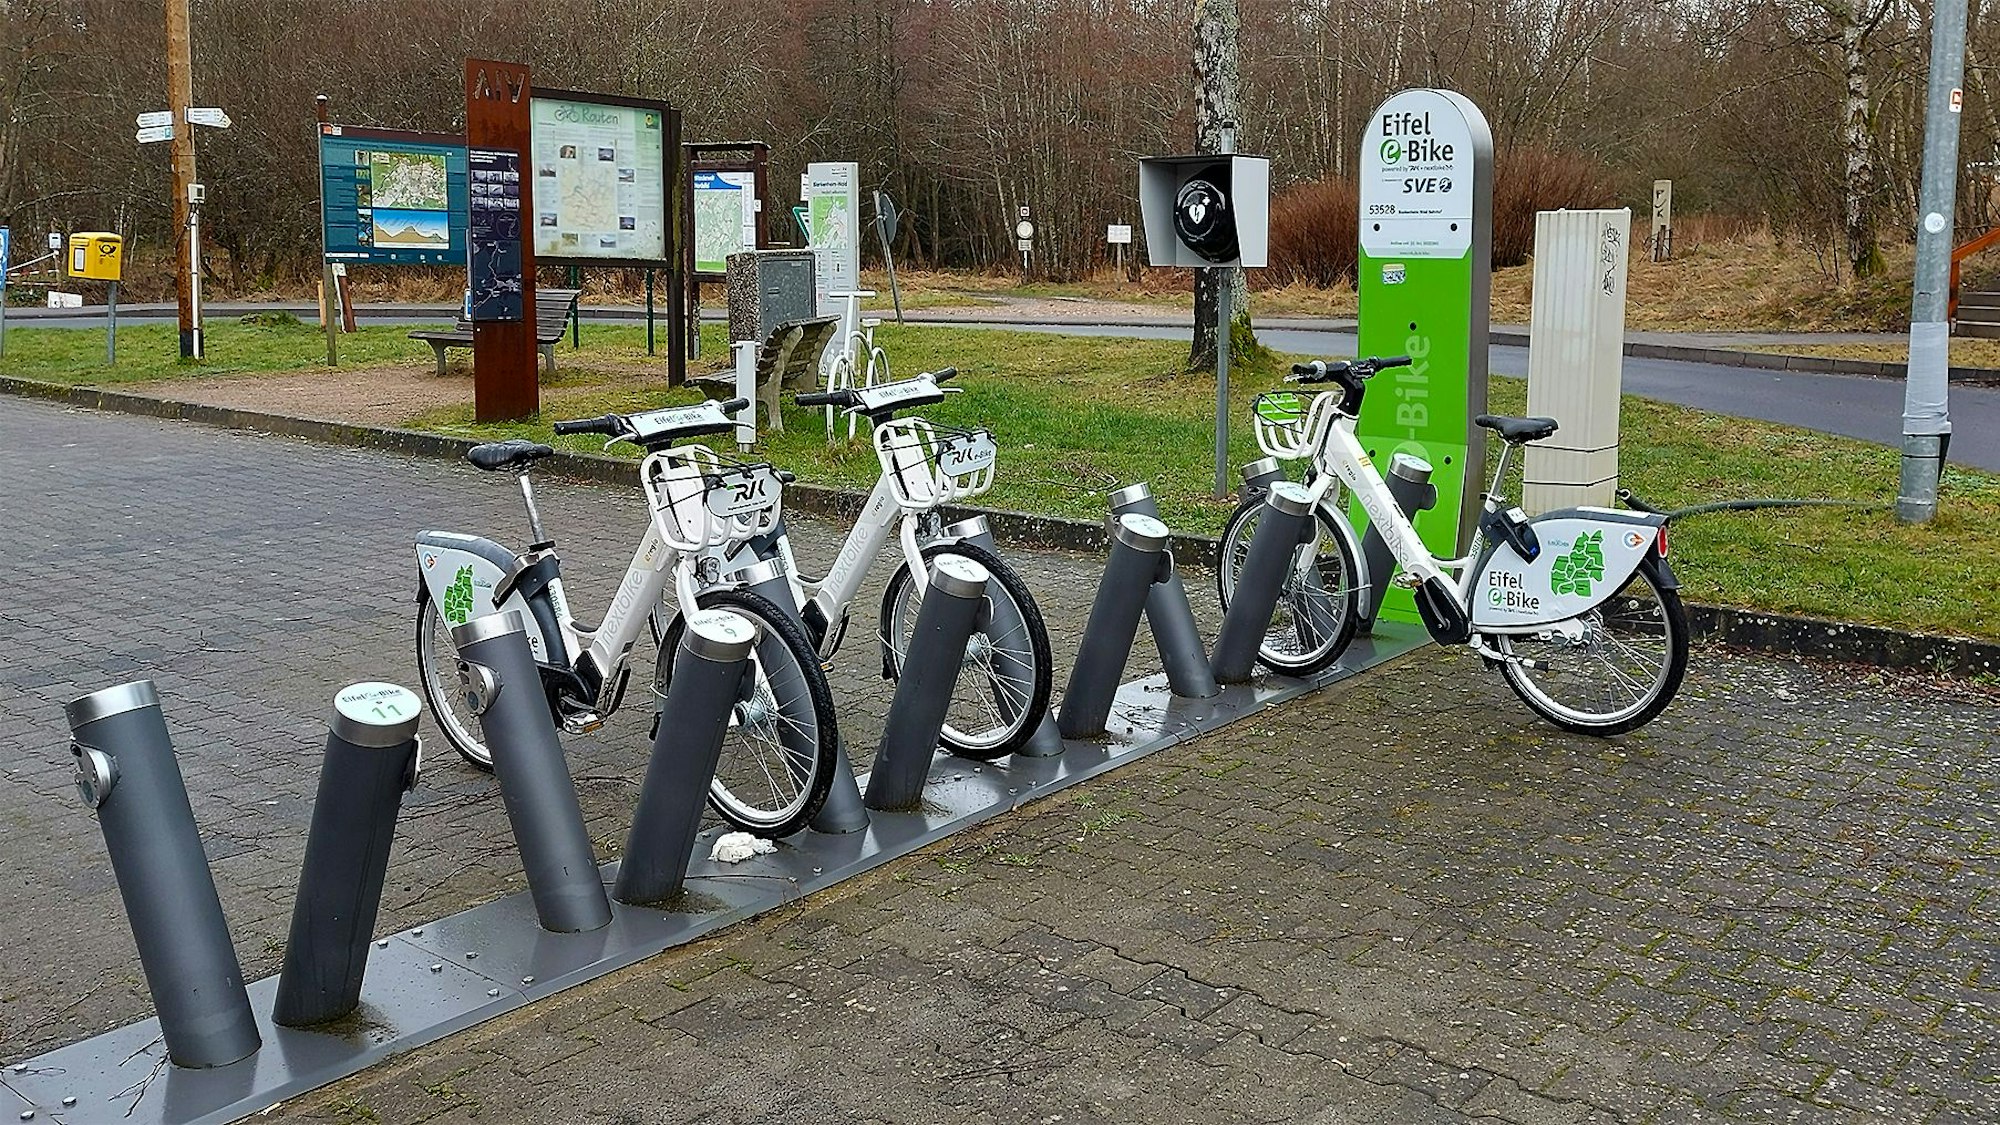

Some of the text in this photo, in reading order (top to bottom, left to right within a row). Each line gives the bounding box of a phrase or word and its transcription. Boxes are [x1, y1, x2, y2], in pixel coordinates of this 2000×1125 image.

[582, 107, 619, 124] Routen
[1383, 111, 1431, 136] Eifel
[1380, 138, 1454, 165] e-Bike
[1403, 178, 1438, 193] SVE
[1369, 204, 1396, 215] 53528
[654, 415, 676, 424] Eifel
[1362, 494, 1409, 562] nextbike
[830, 527, 868, 593] nextbike
[1489, 571, 1523, 589] Eifel
[1488, 587, 1539, 609] e-Bike
[602, 570, 642, 648] nextbike
[724, 627, 738, 637] 9
[341, 694, 366, 703] Eifel
[371, 704, 402, 719] 11
